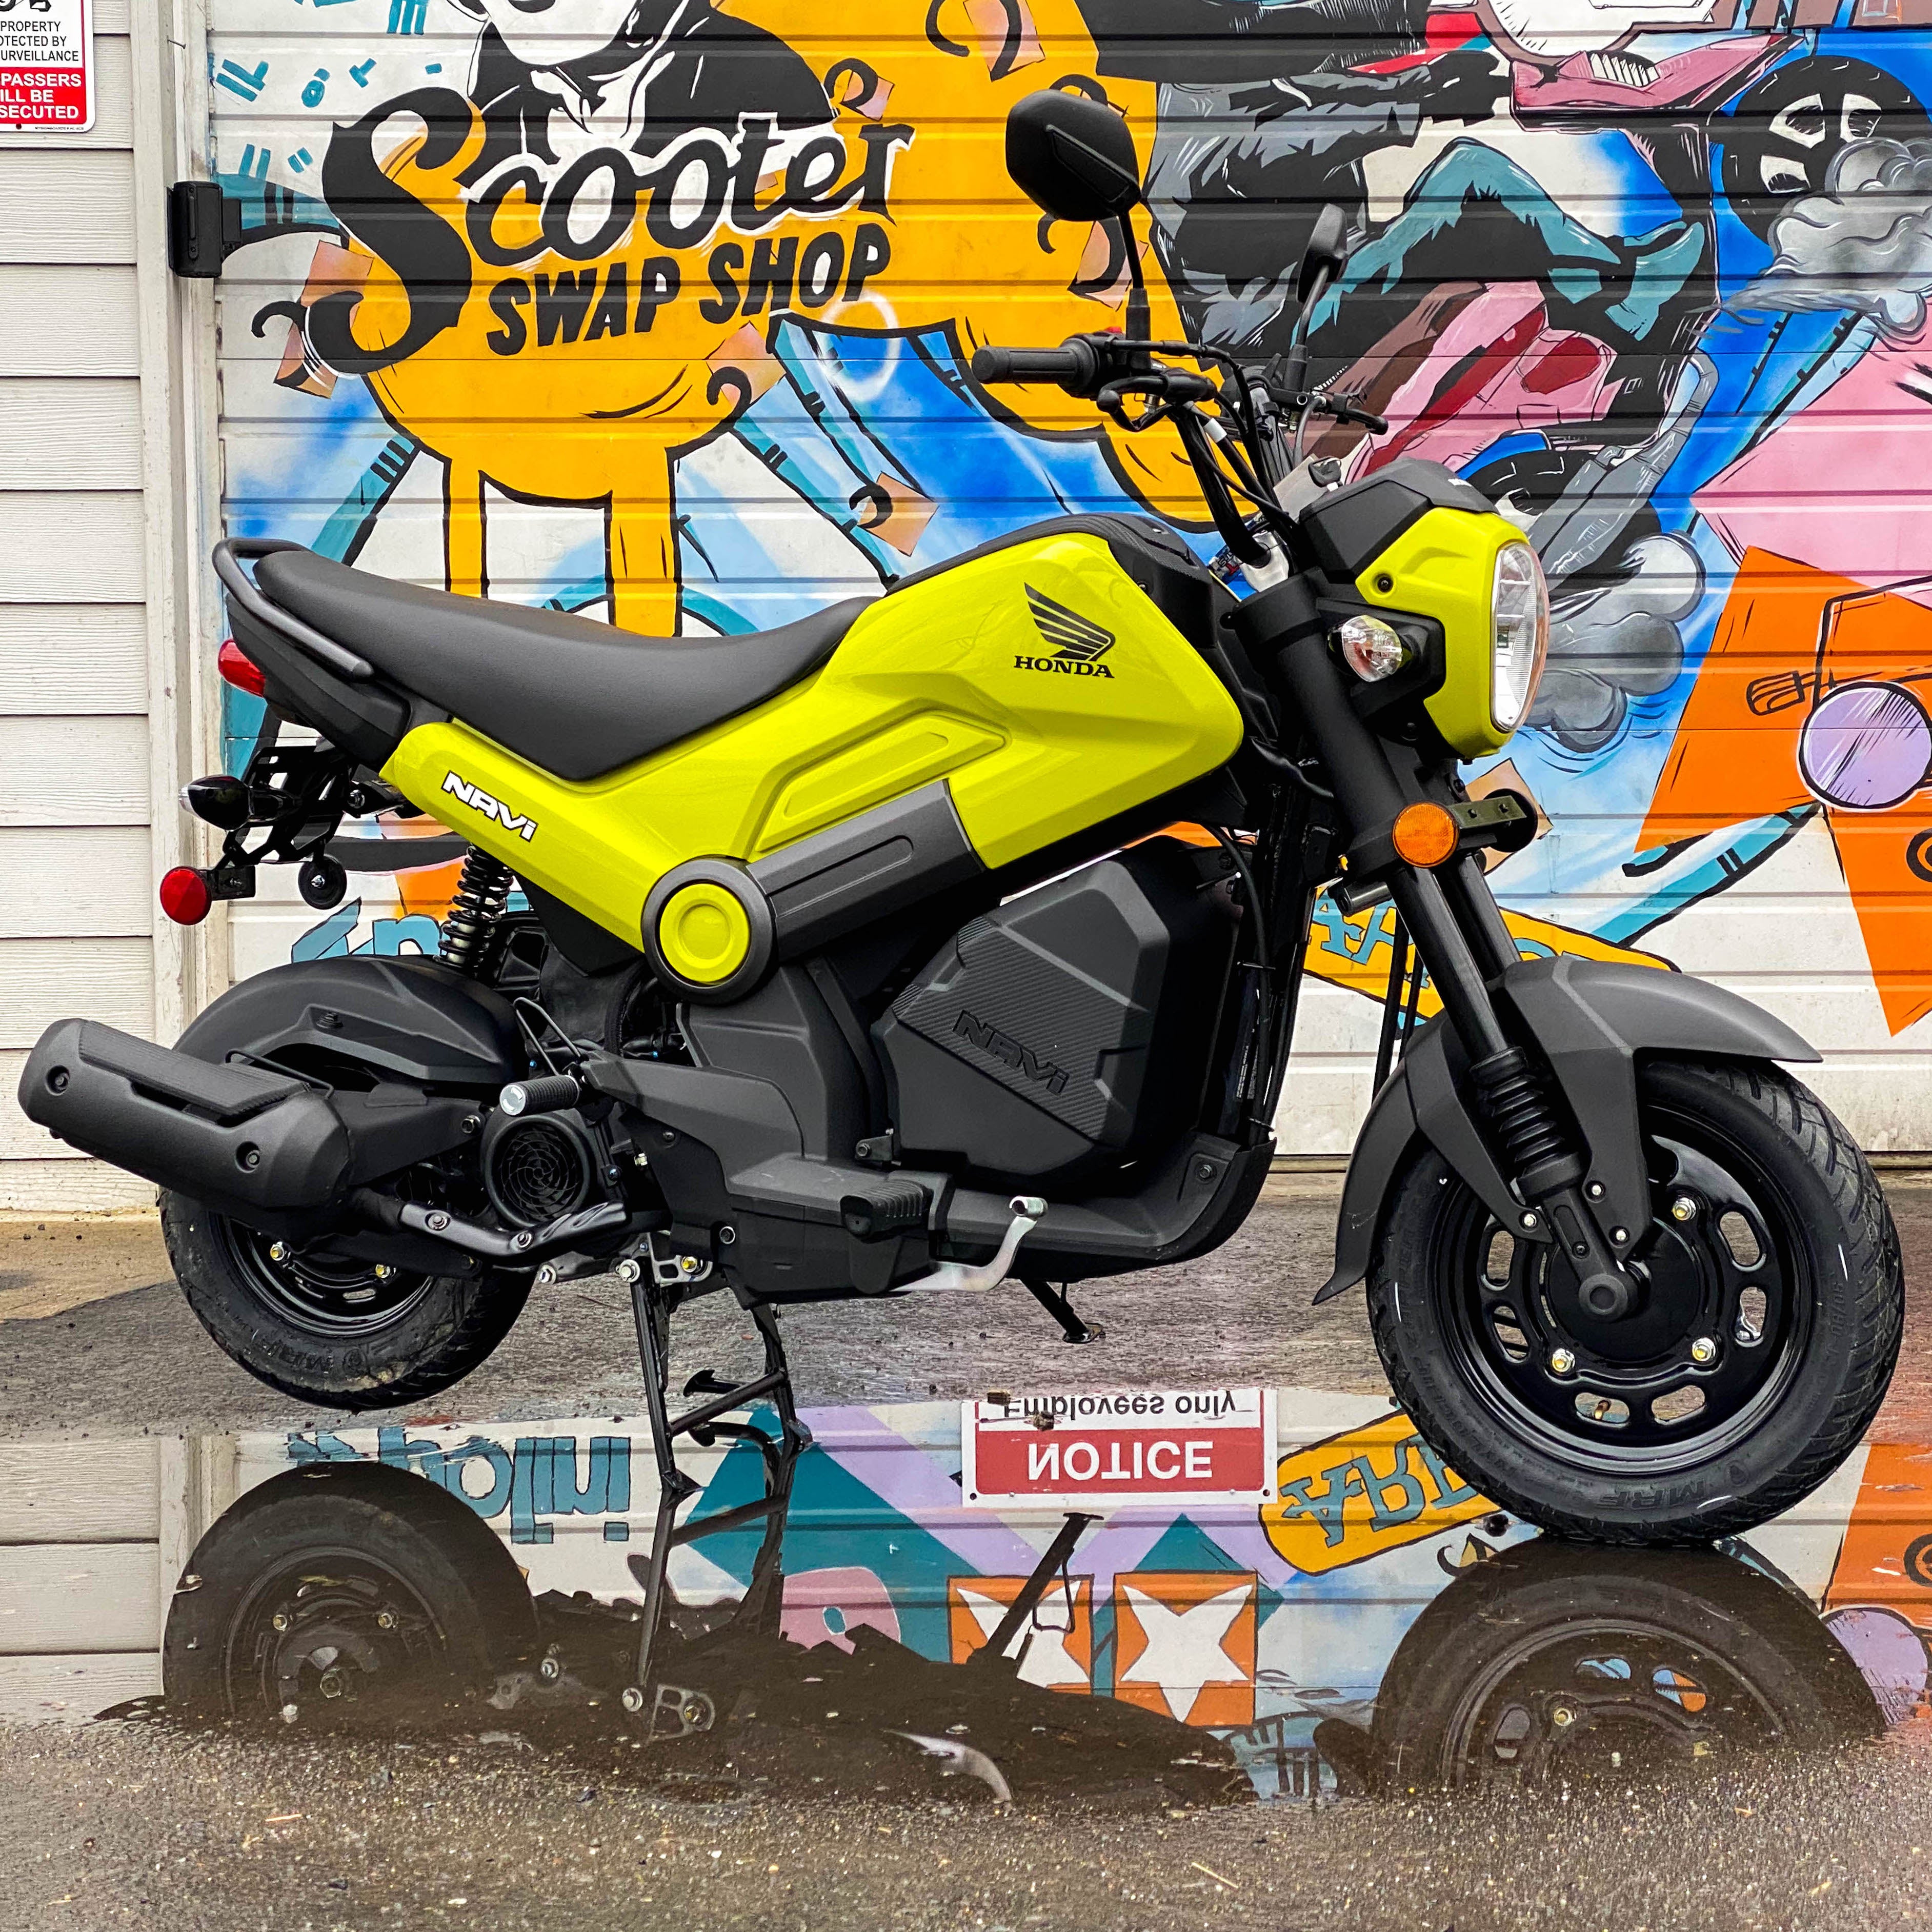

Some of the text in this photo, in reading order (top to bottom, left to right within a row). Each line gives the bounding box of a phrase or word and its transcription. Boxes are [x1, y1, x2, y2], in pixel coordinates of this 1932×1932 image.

[1, 21, 61, 32] PROPERTY
[52, 36, 67, 47] BY
[30, 89, 54, 103] BE
[486, 223, 892, 356] SWAP SHOP
[1014, 655, 1115, 679] HONDA
